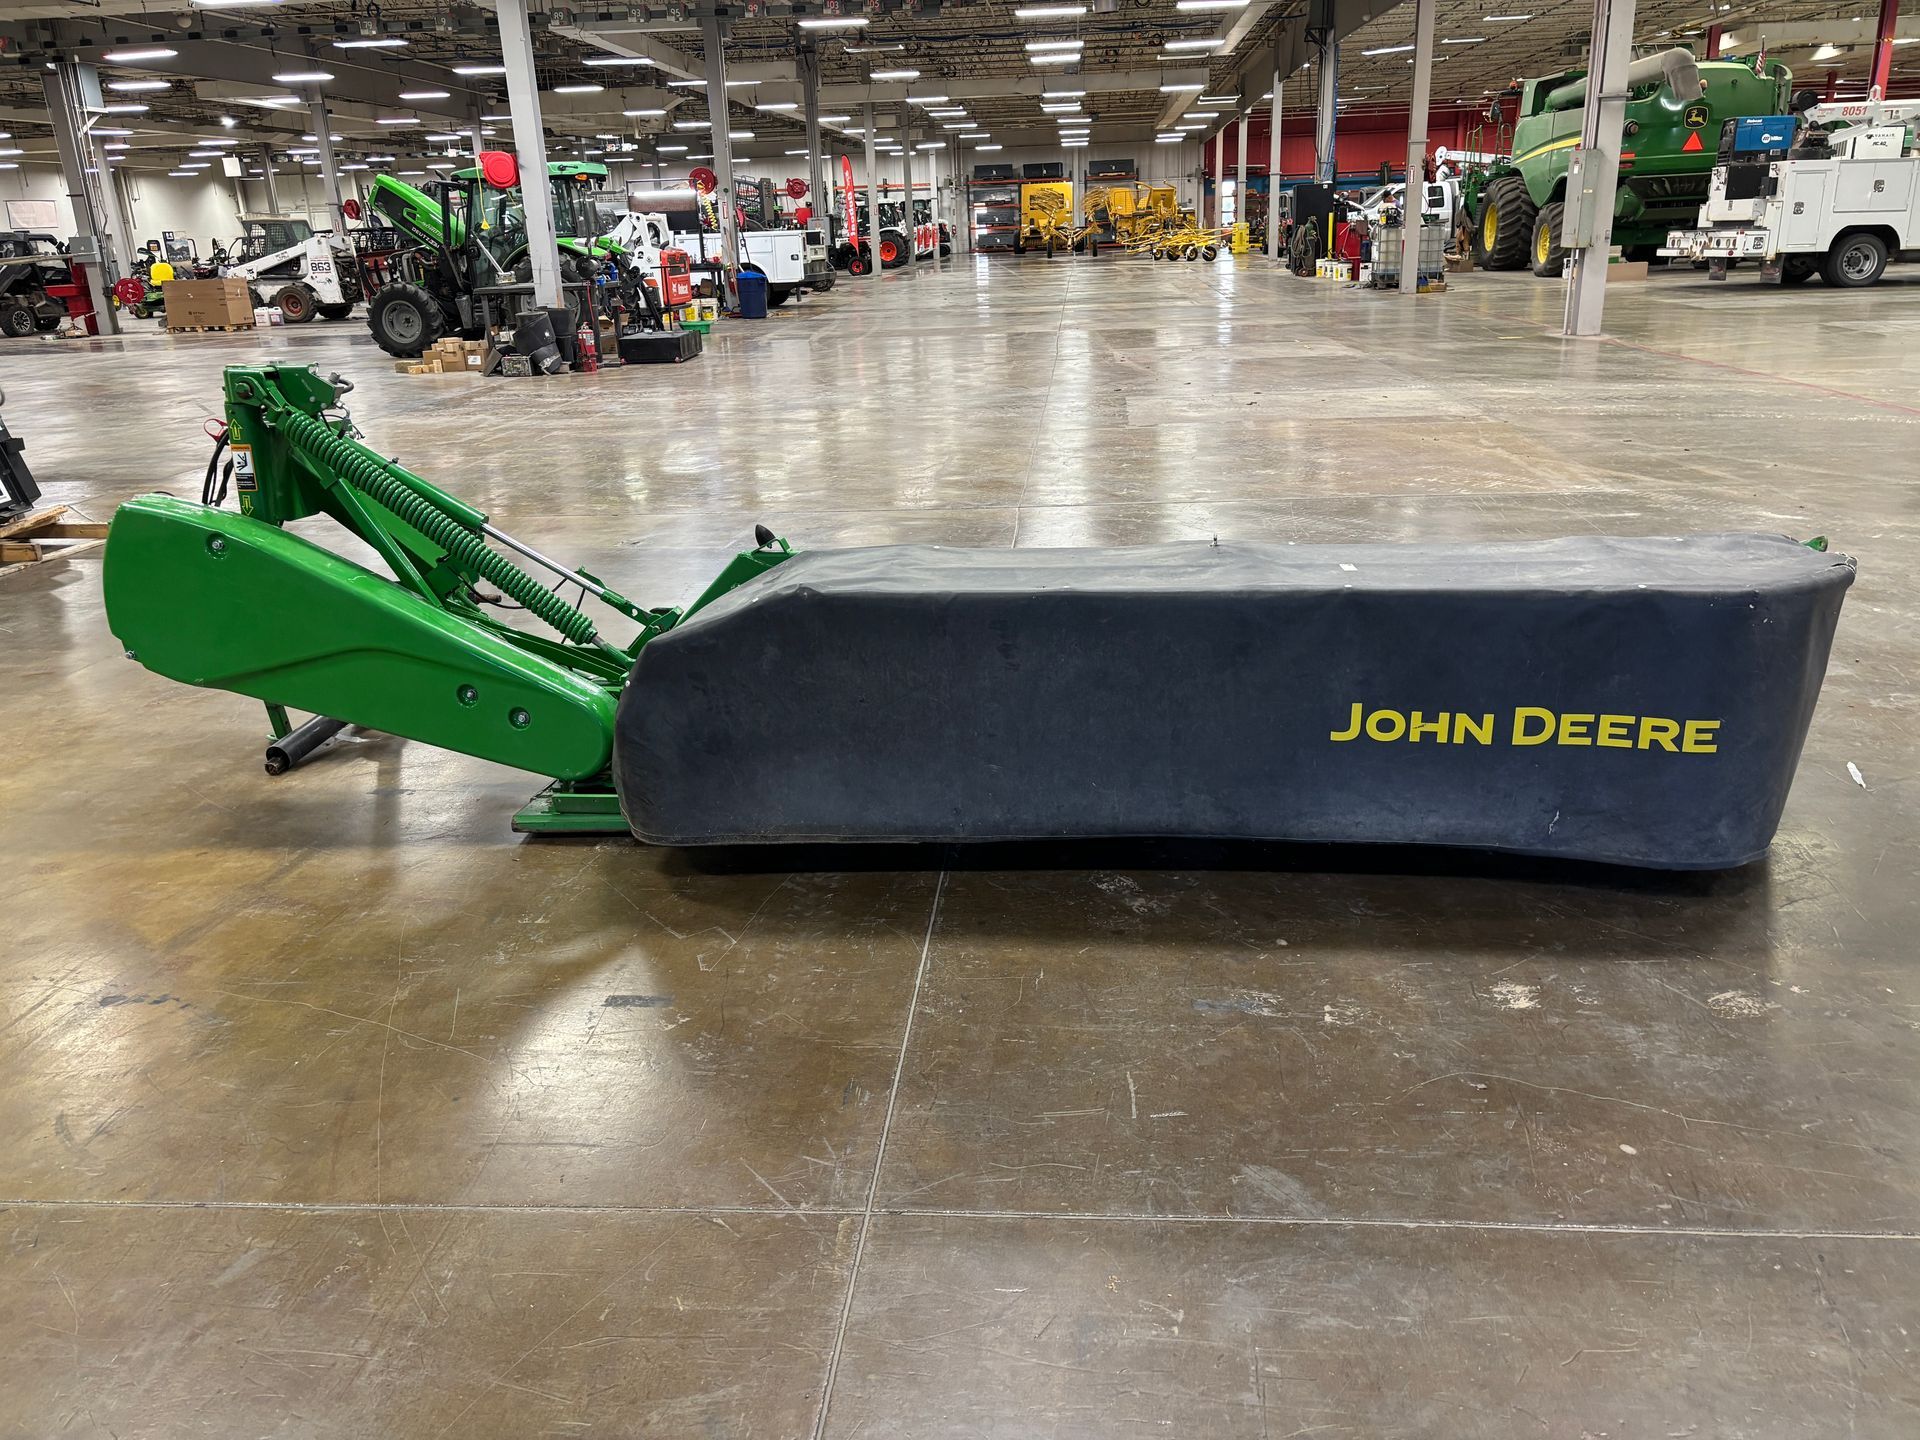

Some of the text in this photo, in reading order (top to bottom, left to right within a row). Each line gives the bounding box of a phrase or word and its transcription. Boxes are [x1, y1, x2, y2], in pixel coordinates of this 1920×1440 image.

[631, 8, 641, 17] 93
[670, 8, 681, 17] 95
[1842, 105, 1868, 117] 8051
[310, 262, 332, 272] 863
[1329, 702, 1721, 753] JOHN DEERE
